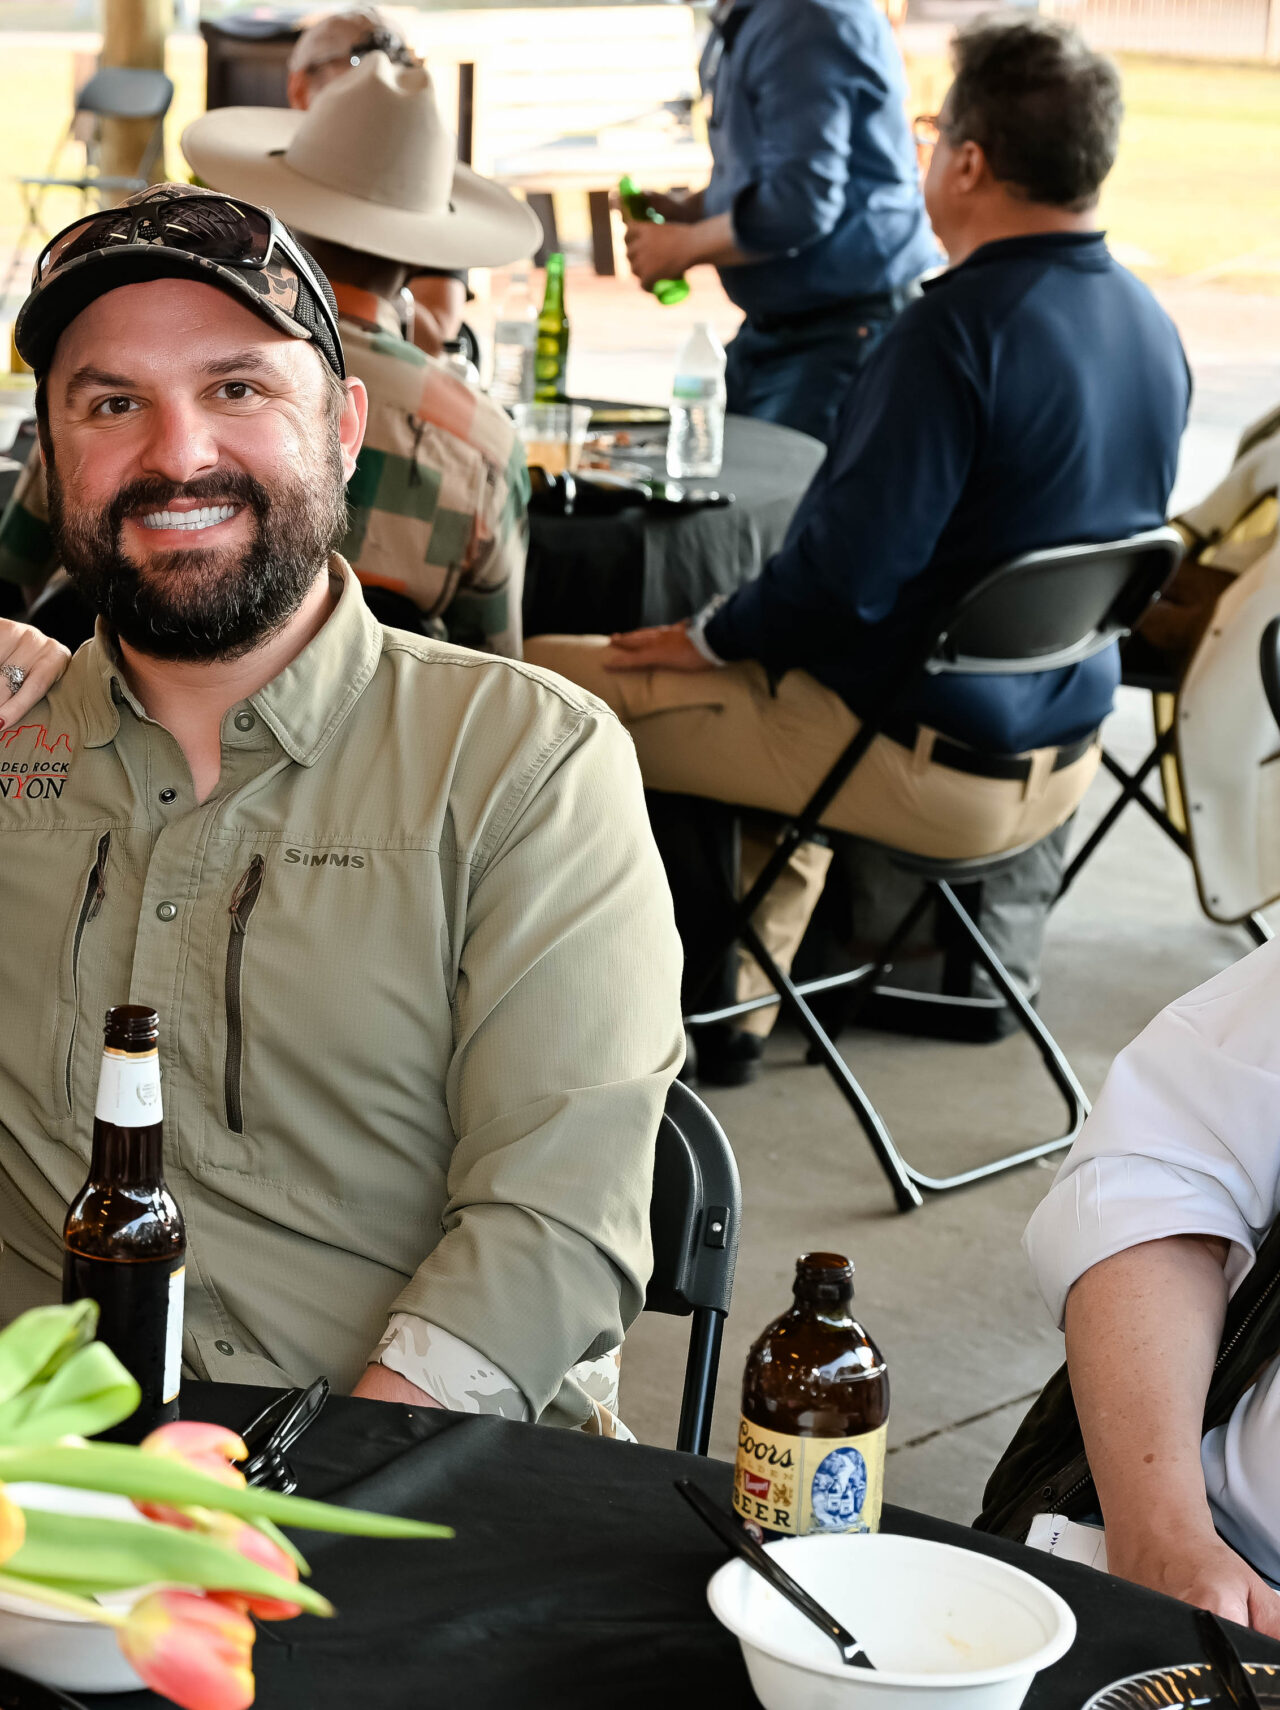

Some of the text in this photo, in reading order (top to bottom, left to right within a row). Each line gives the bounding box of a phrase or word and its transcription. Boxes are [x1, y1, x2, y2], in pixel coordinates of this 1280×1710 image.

[32, 762, 70, 773] ROCK
[283, 848, 365, 869] SIMMS
[738, 1421, 795, 1468] Coors
